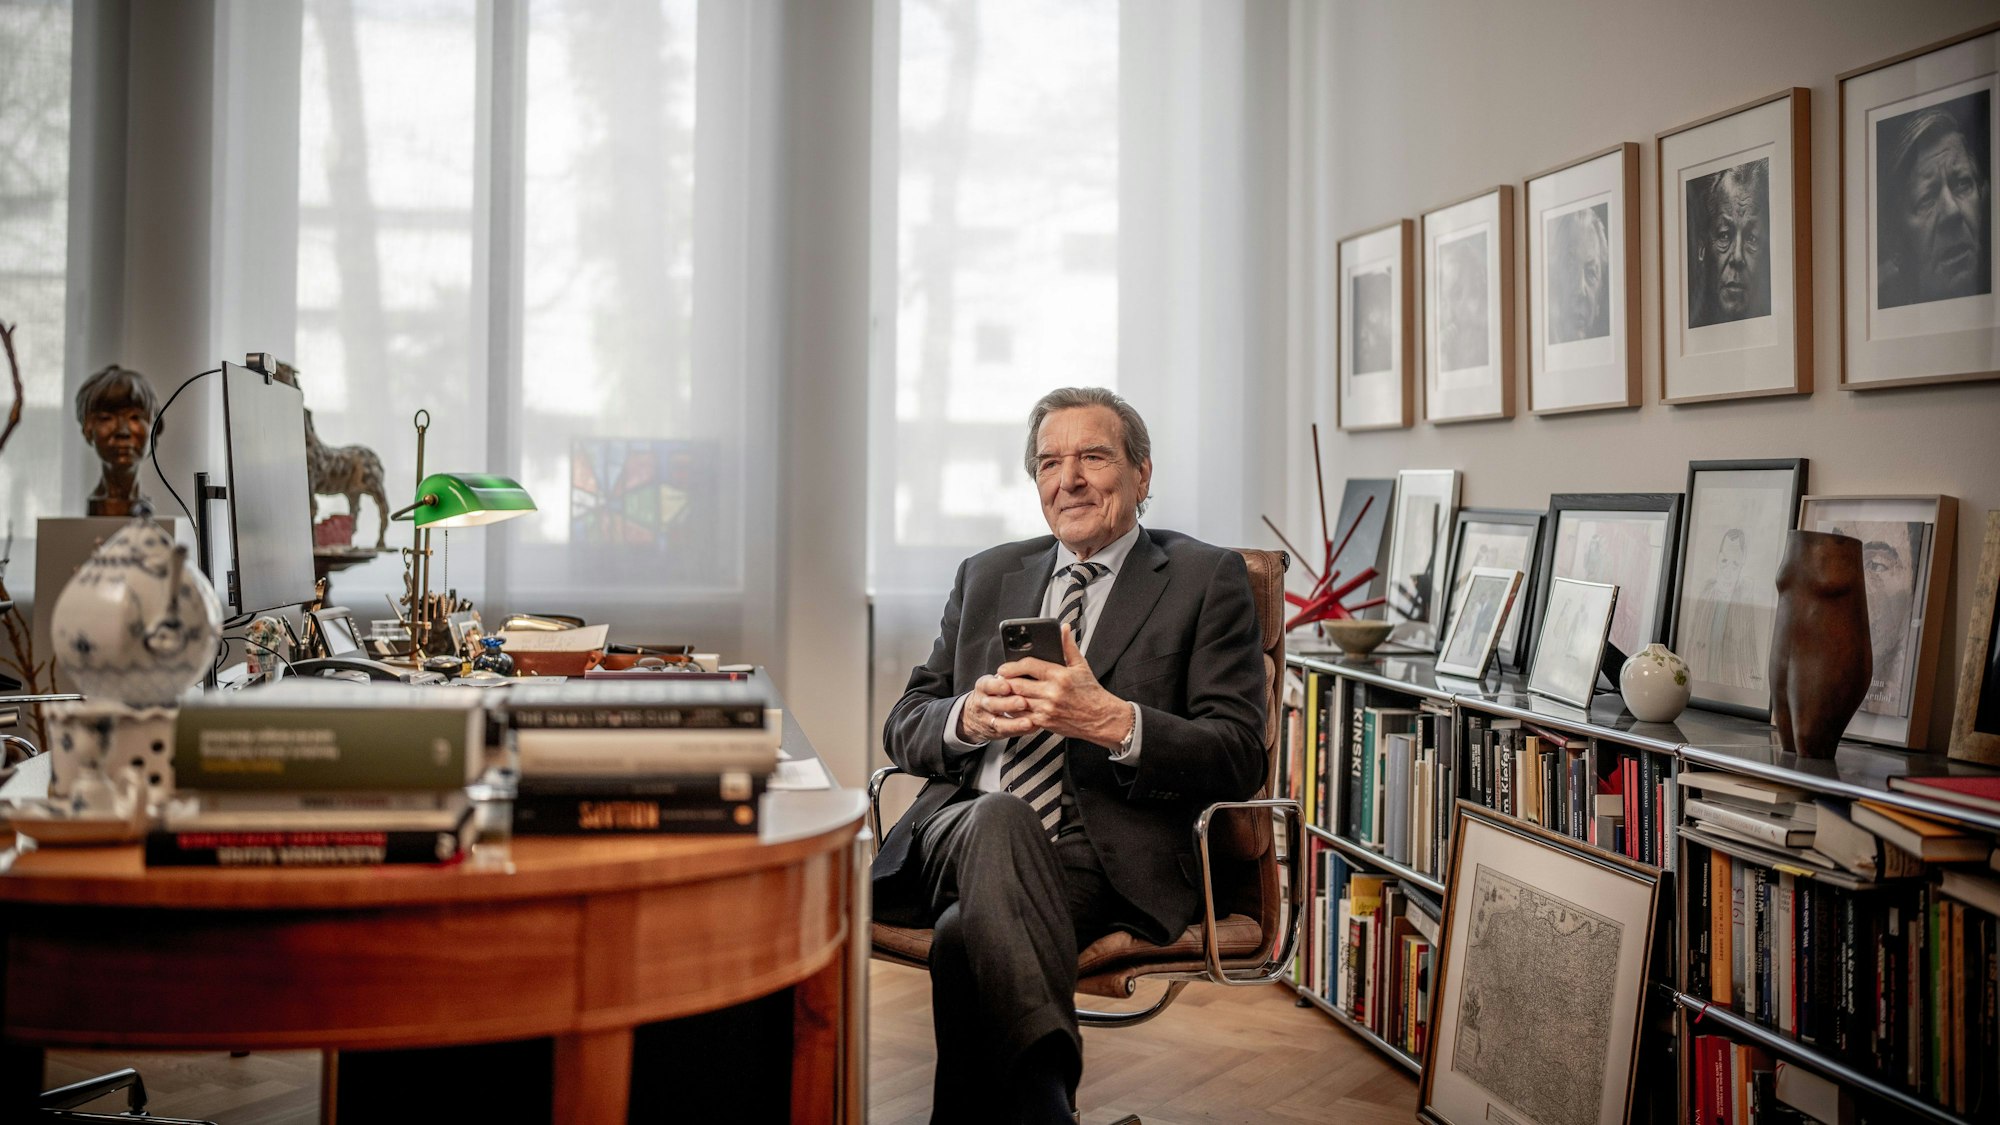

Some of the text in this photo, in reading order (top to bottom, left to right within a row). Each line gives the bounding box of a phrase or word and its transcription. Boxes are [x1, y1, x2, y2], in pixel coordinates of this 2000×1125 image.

[1351, 707, 1363, 777] KINSKI
[1501, 745, 1510, 793] Kiefer
[1733, 888, 1745, 926] 1913
